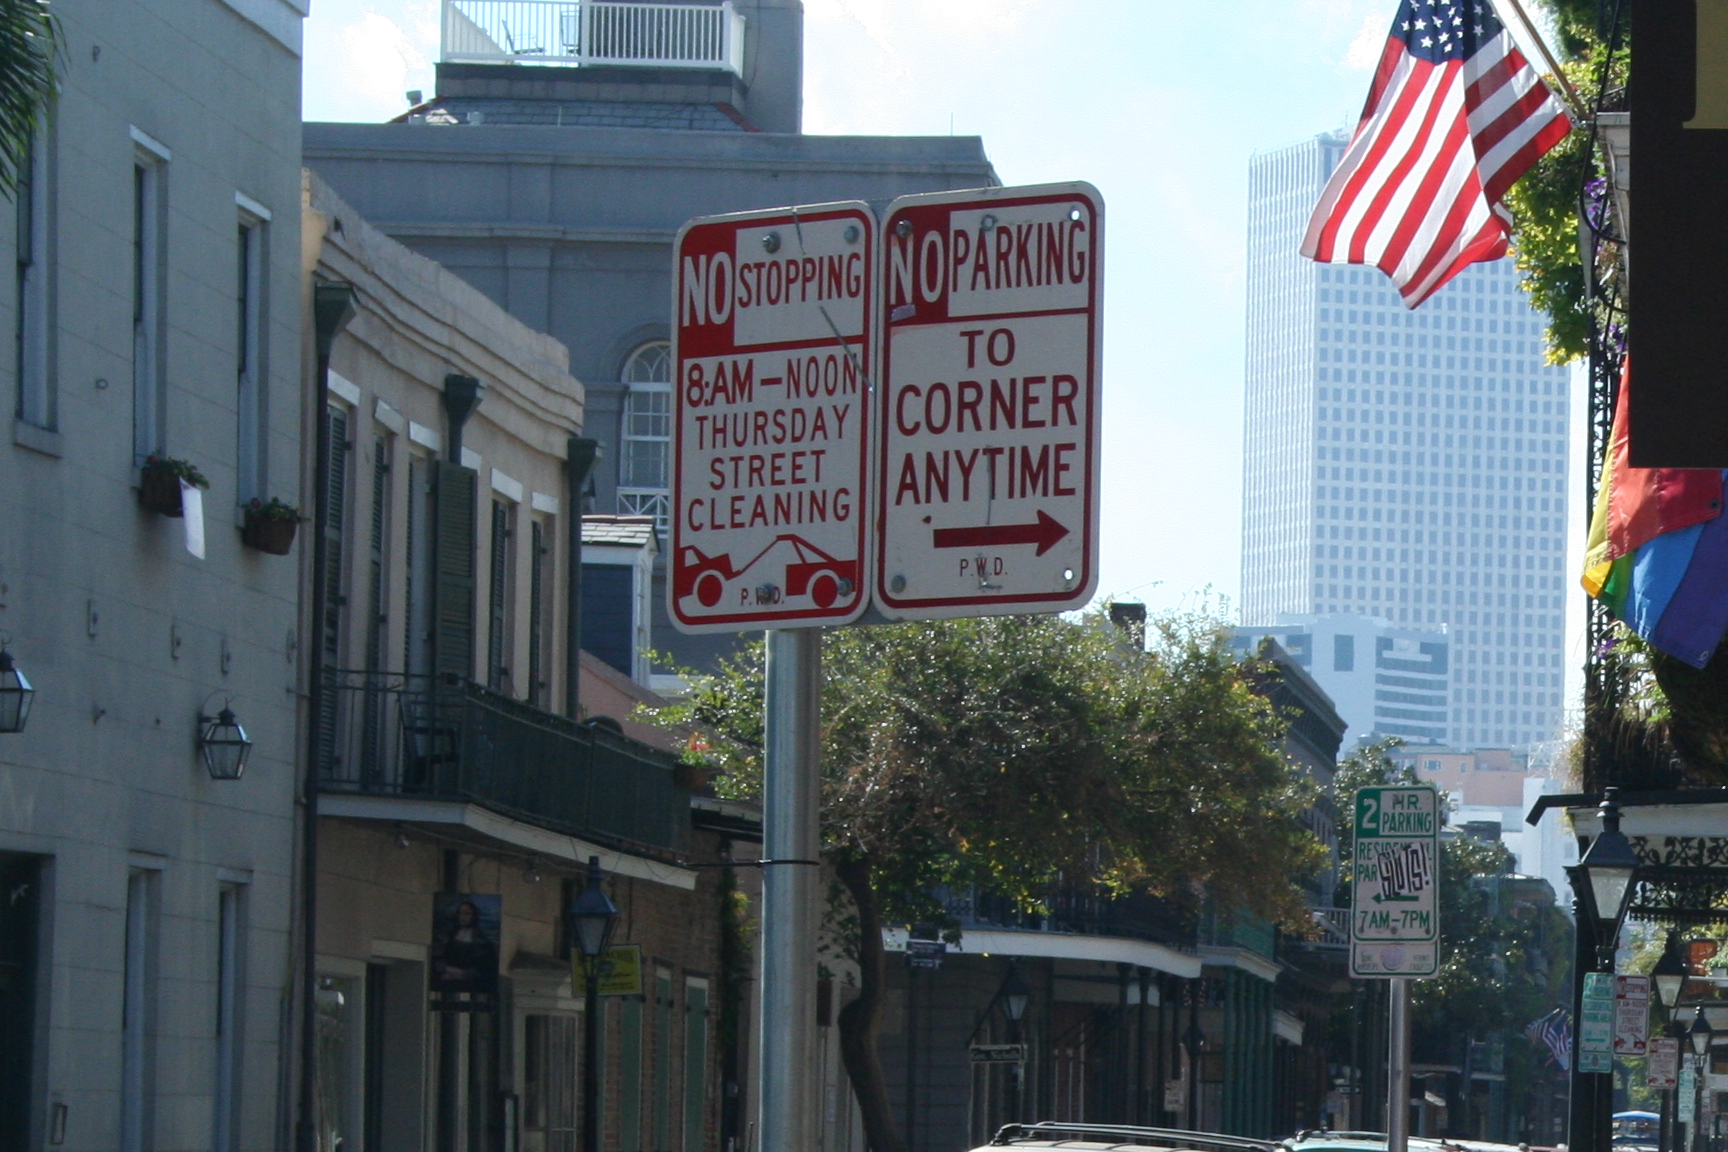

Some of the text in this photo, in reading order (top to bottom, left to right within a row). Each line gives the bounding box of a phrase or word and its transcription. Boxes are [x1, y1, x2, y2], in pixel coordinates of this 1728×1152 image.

[890, 220, 1086, 305] NO PARKING
[682, 251, 862, 327] NO STOPPING
[960, 328, 1016, 370] TO
[787, 353, 858, 399] NOON
[695, 404, 850, 450] THURSDAY
[896, 374, 1079, 436] CORNER
[709, 450, 826, 491] STREET
[895, 443, 1076, 506] ANYTIME
[687, 488, 851, 532] CLEANING
[1362, 798, 1378, 830] 2
[1382, 812, 1432, 833] PARKING
